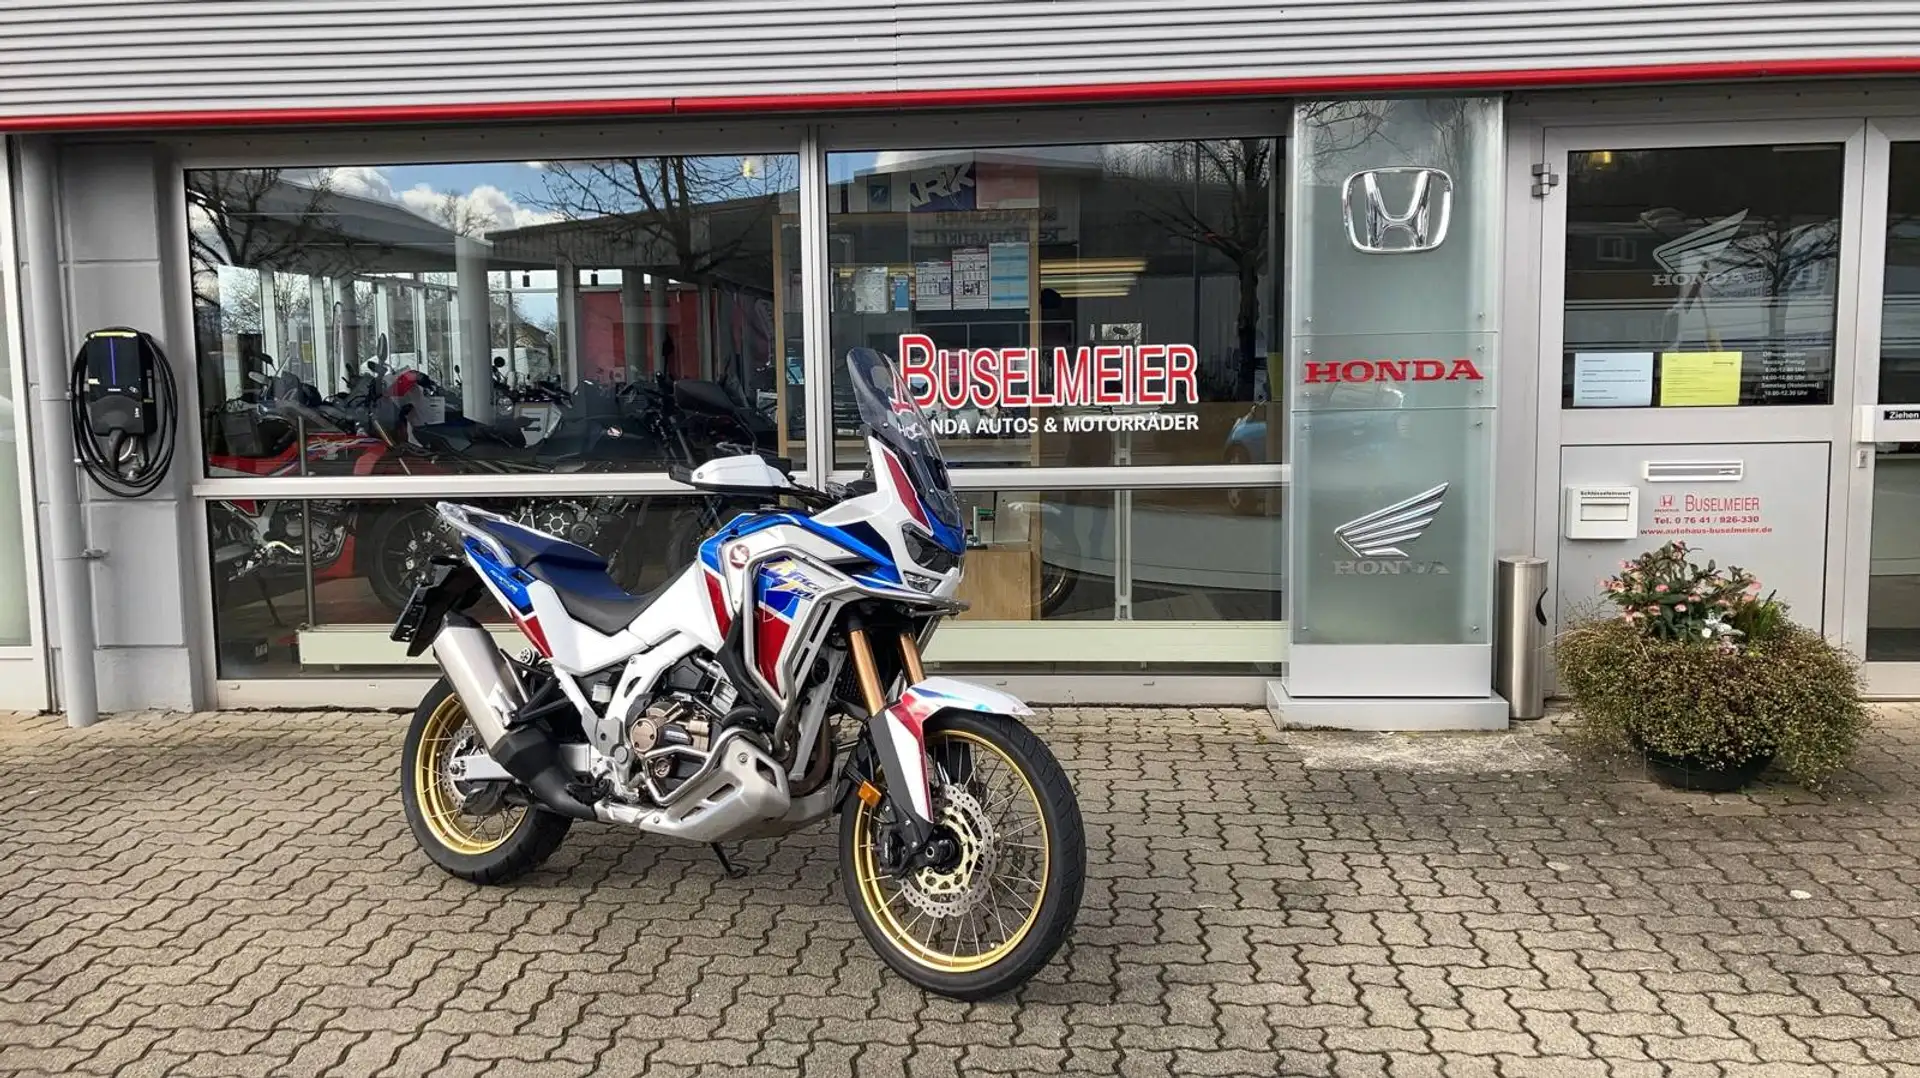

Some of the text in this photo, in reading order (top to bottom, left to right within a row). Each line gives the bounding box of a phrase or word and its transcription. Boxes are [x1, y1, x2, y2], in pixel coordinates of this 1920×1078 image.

[899, 333, 1199, 410] BUSELMEIER
[1304, 359, 1485, 383] HONDA
[976, 417, 1039, 434] AUTOS
[1044, 416, 1058, 433] &
[1063, 411, 1199, 433] MOTORRÄDER
[1889, 411, 1919, 419] Ziehen
[1685, 494, 1760, 512] BUSELMEIER
[1654, 517, 1672, 525] Tel.
[1675, 516, 1681, 524] 0
[1684, 516, 1696, 524] 76
[1719, 515, 1760, 523] 926-330
[1640, 526, 1773, 535] www.autohaus-buselmeier.de
